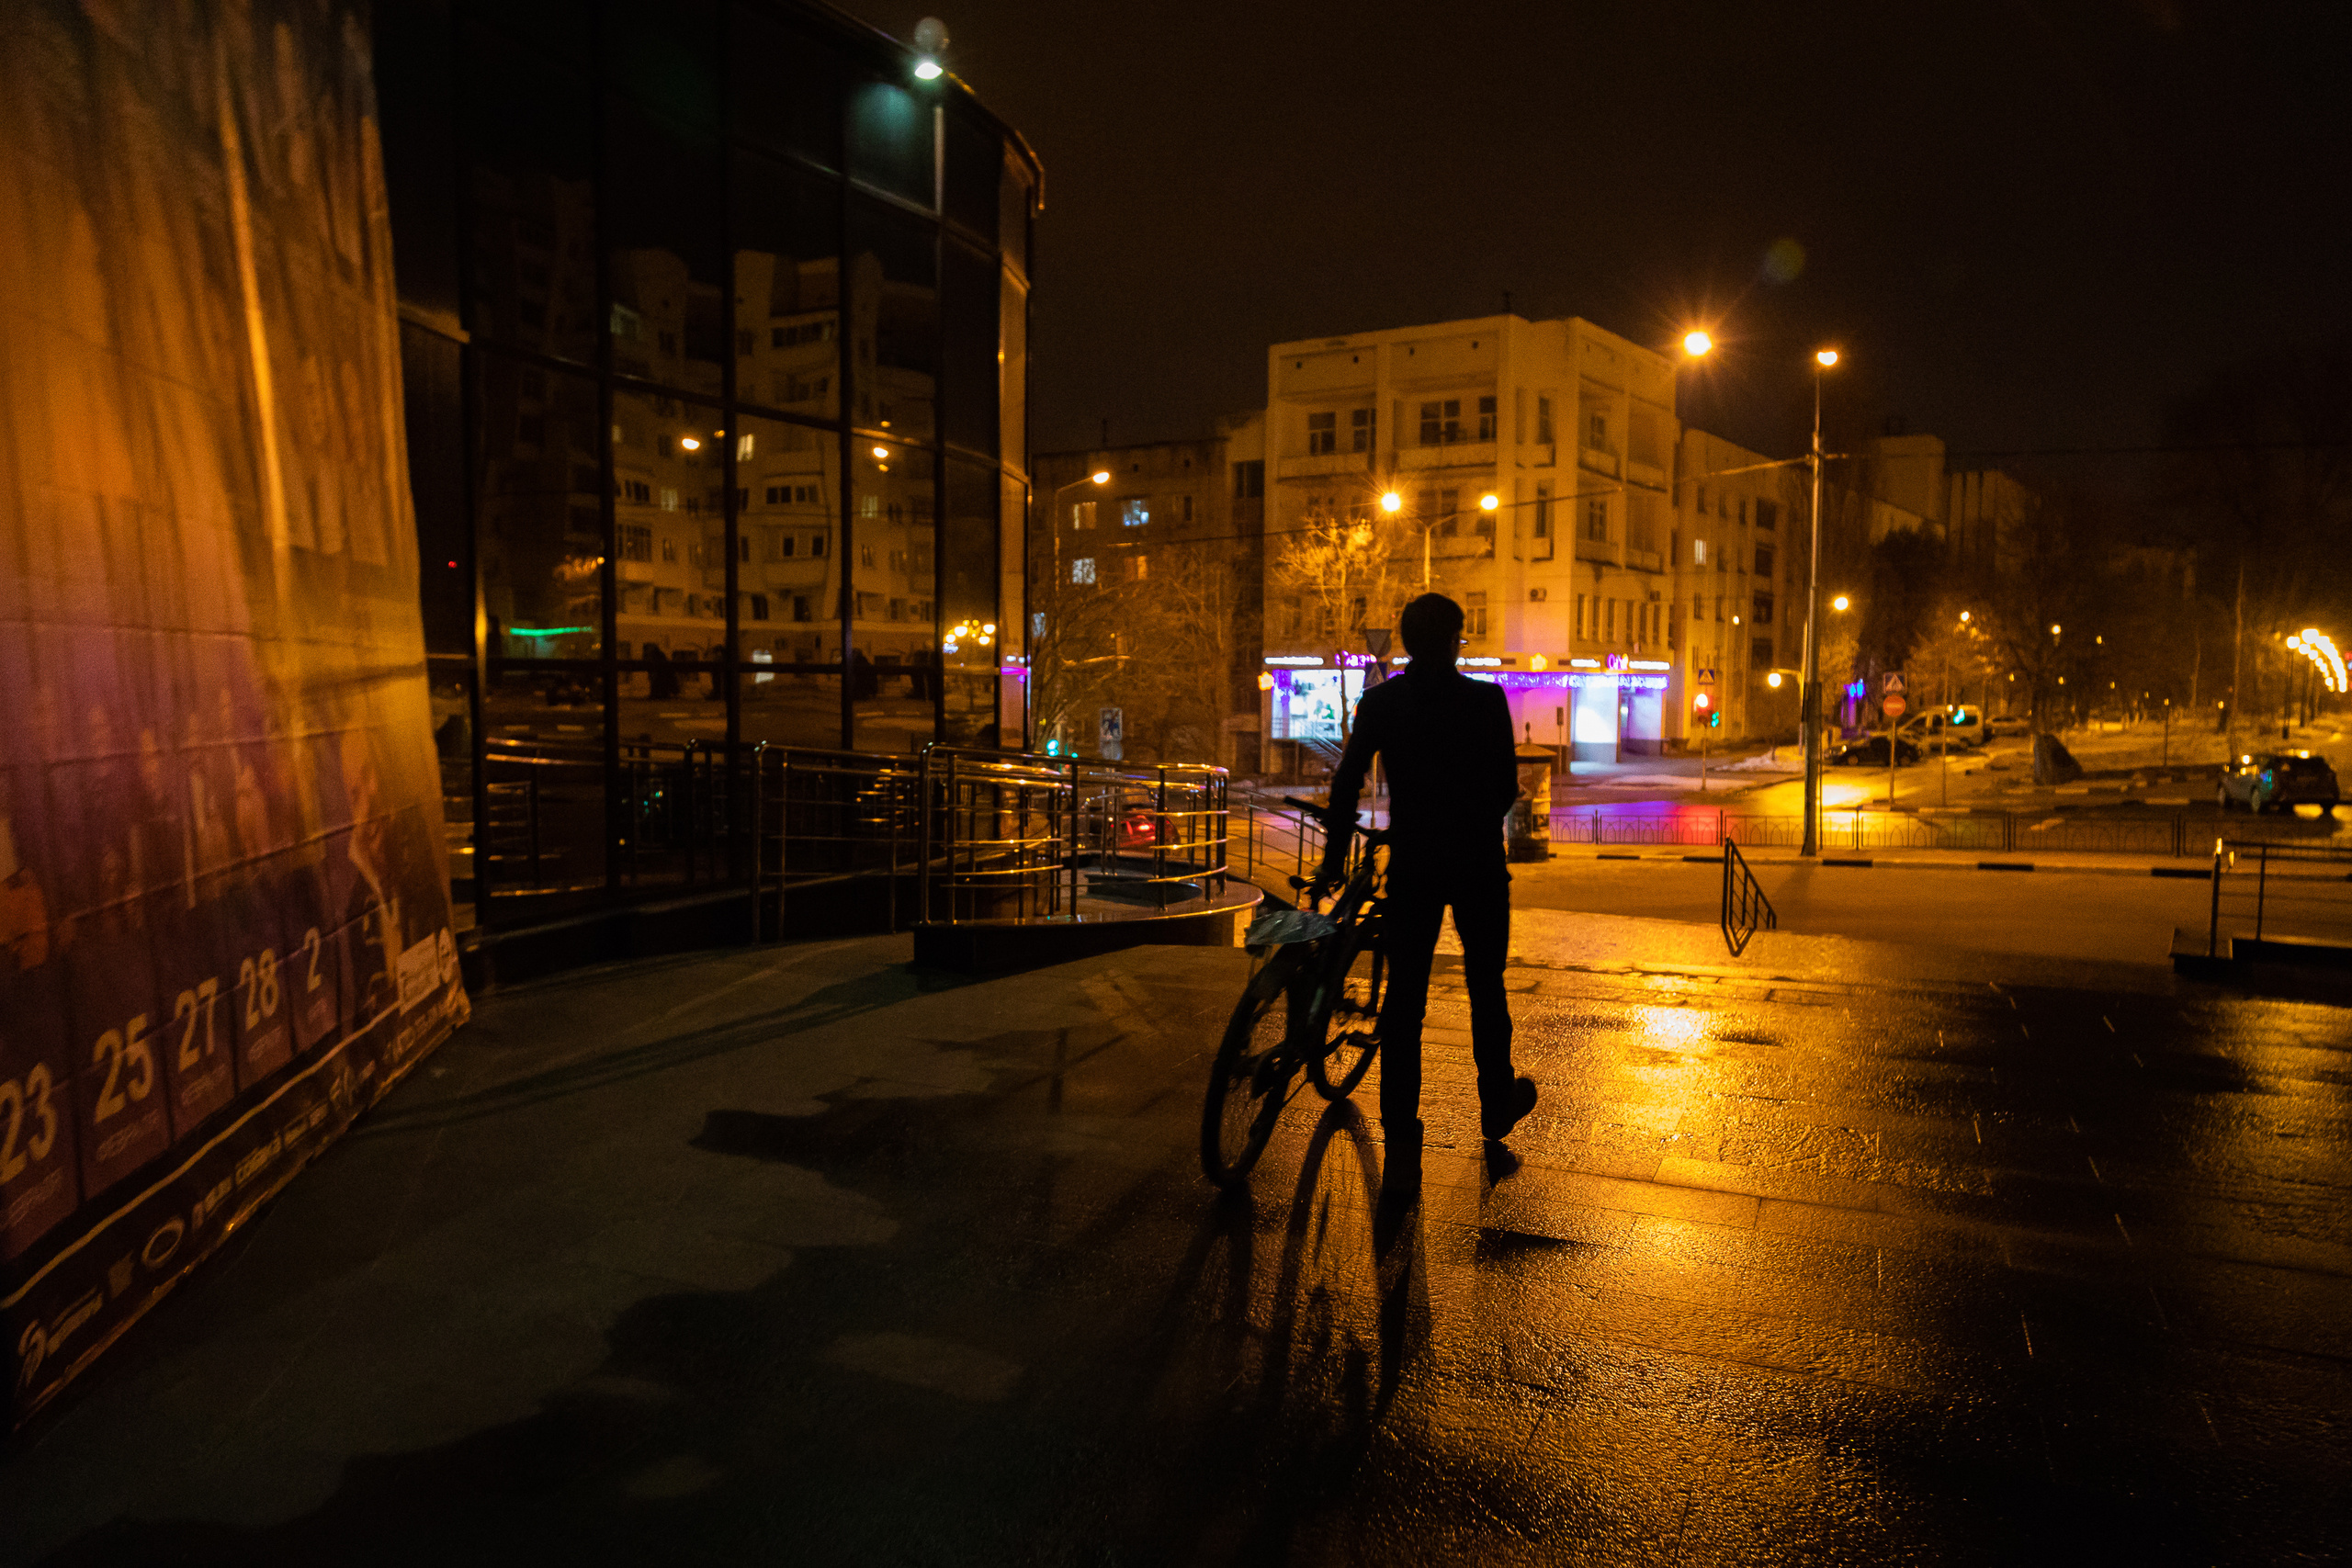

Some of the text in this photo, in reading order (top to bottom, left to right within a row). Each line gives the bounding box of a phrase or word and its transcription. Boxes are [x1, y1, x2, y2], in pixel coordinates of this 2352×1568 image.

[240, 948, 280, 1032] 28
[303, 927, 322, 992] 2
[93, 1013, 153, 1123] 25
[175, 976, 219, 1072] 27
[0, 1062, 57, 1185] 23
